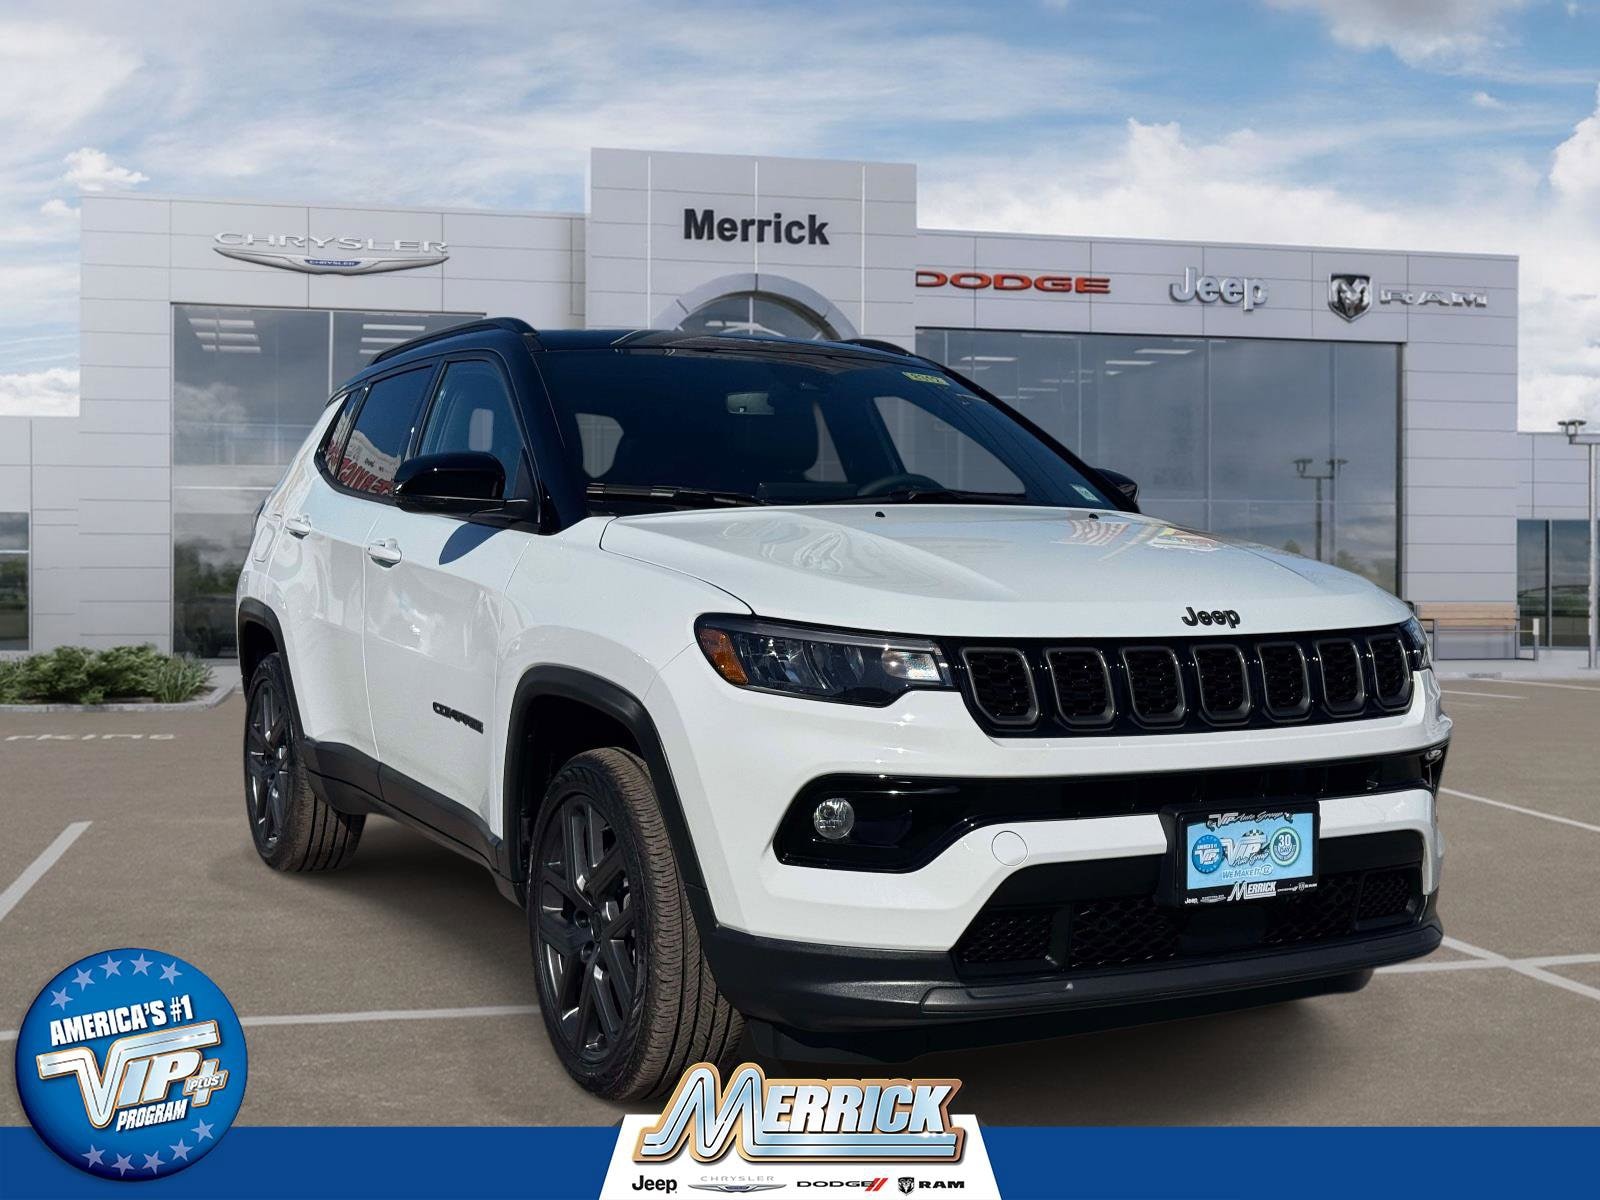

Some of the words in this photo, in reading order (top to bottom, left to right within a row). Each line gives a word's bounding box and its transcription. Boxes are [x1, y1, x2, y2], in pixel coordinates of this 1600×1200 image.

[683, 208, 830, 245] Merrick
[213, 232, 448, 253] CHRYSLER
[915, 271, 1111, 294] DODGE
[1169, 266, 1268, 312] Jeep
[1380, 289, 1488, 308] RAM
[1181, 606, 1240, 629] Jeep
[1220, 834, 1268, 866] VIP
[1279, 834, 1291, 846] 30
[1227, 880, 1277, 902] MERRICK
